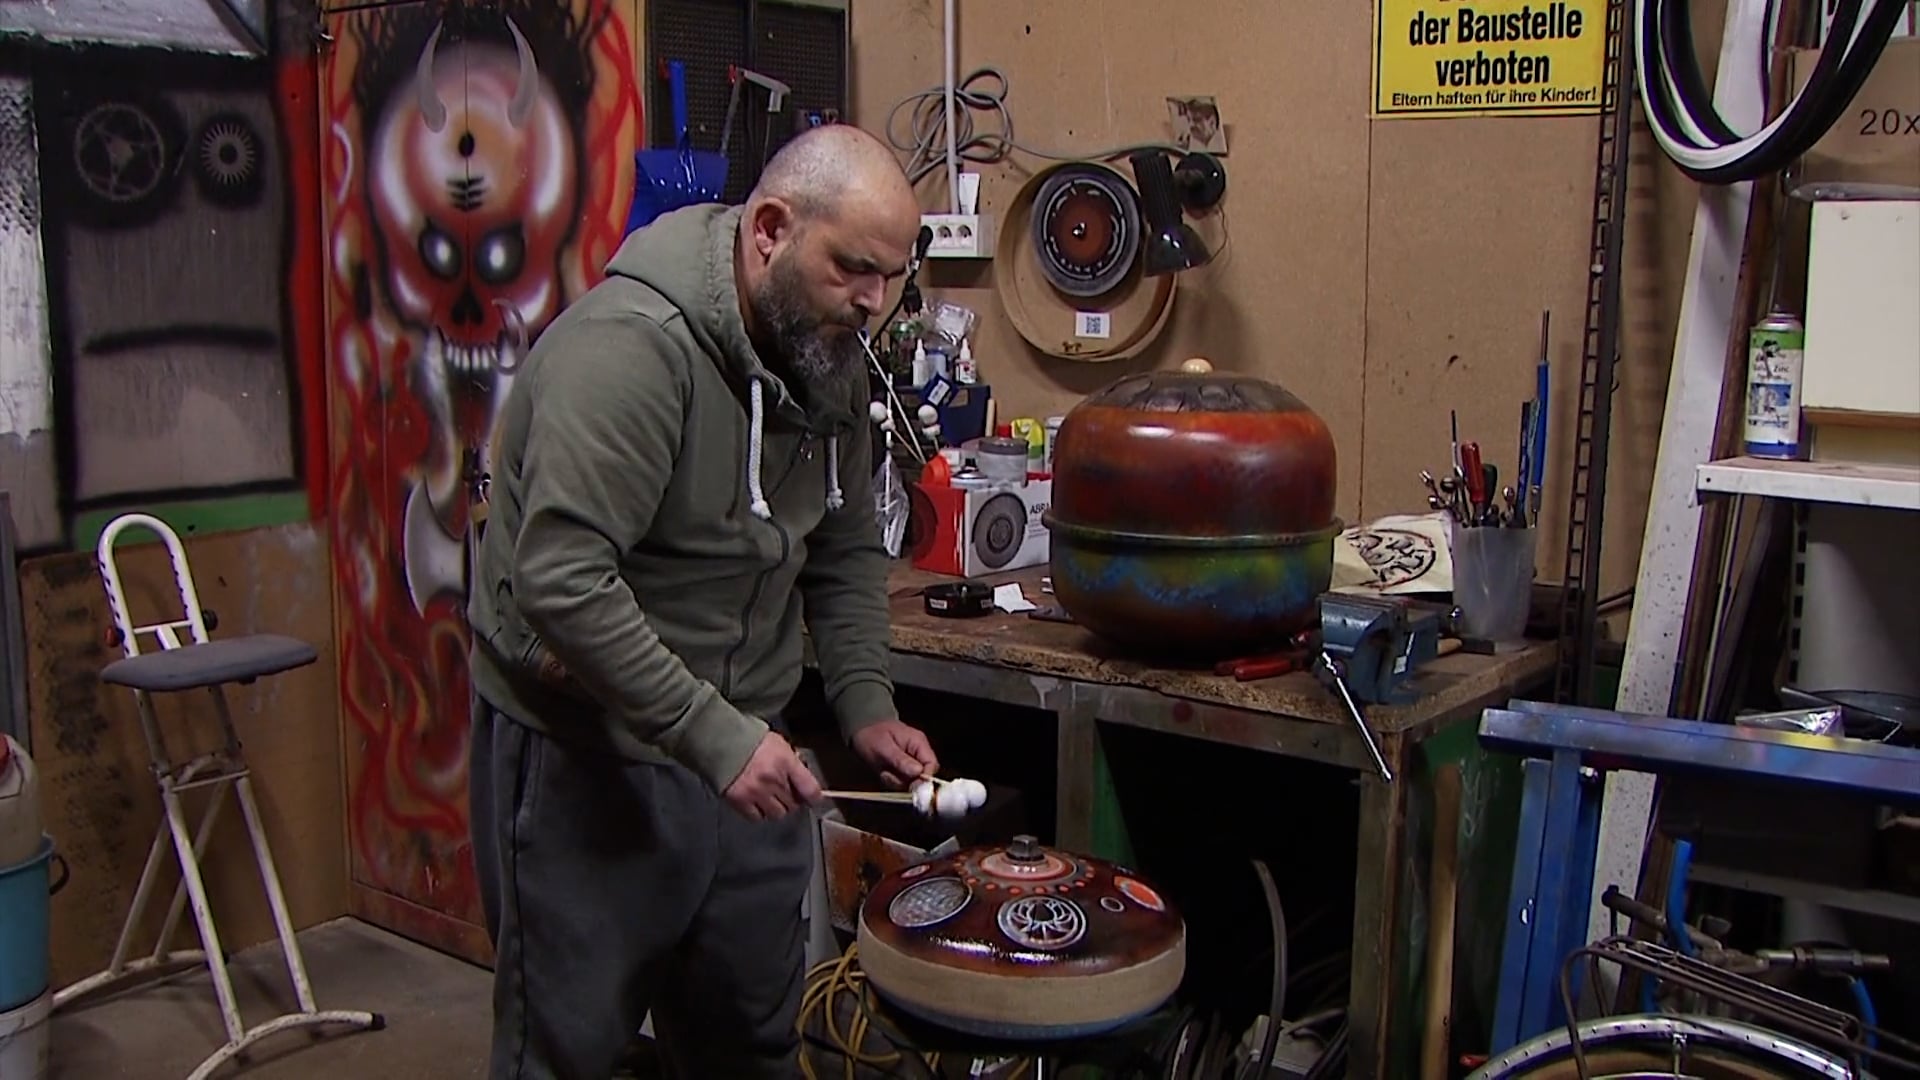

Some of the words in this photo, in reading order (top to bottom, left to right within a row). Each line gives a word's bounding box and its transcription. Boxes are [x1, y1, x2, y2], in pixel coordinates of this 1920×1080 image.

[1409, 10, 1450, 46] der
[1457, 3, 1583, 43] Baustelle
[1435, 50, 1550, 87] verboten
[1391, 92, 1433, 106] Eltern
[1436, 91, 1482, 105] haften
[1485, 90, 1505, 104] für
[1509, 89, 1537, 103] ihre
[1541, 86, 1597, 102] Kinder!
[1860, 108, 1920, 135] 20x
